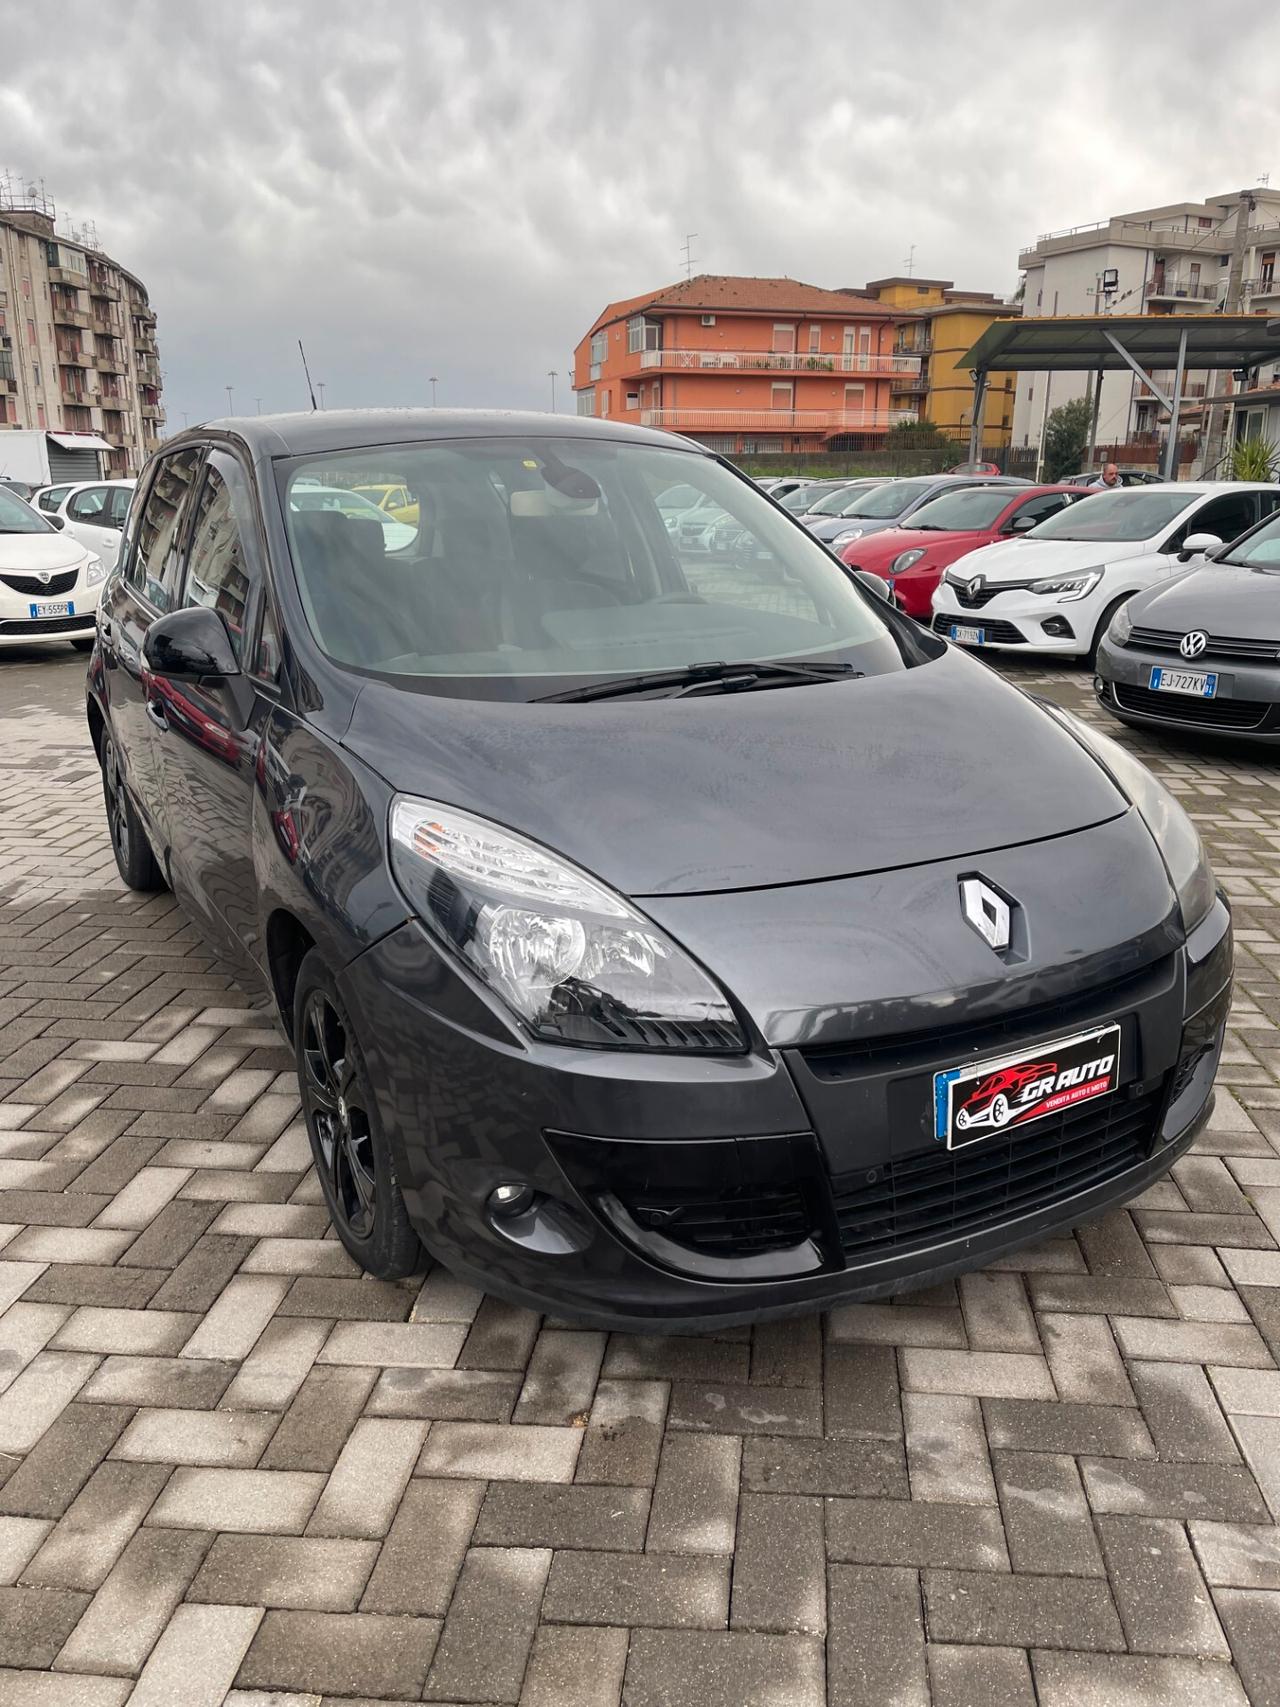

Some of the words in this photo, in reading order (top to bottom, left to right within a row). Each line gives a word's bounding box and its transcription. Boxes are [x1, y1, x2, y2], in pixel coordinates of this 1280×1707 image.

[1019, 1076, 1056, 1103] GR
[1055, 1054, 1115, 1091] AUTO
[1046, 1096, 1070, 1109] VENDITA
[1071, 1087, 1087, 1099] AUTO
[1091, 1081, 1108, 1093] MOTO
